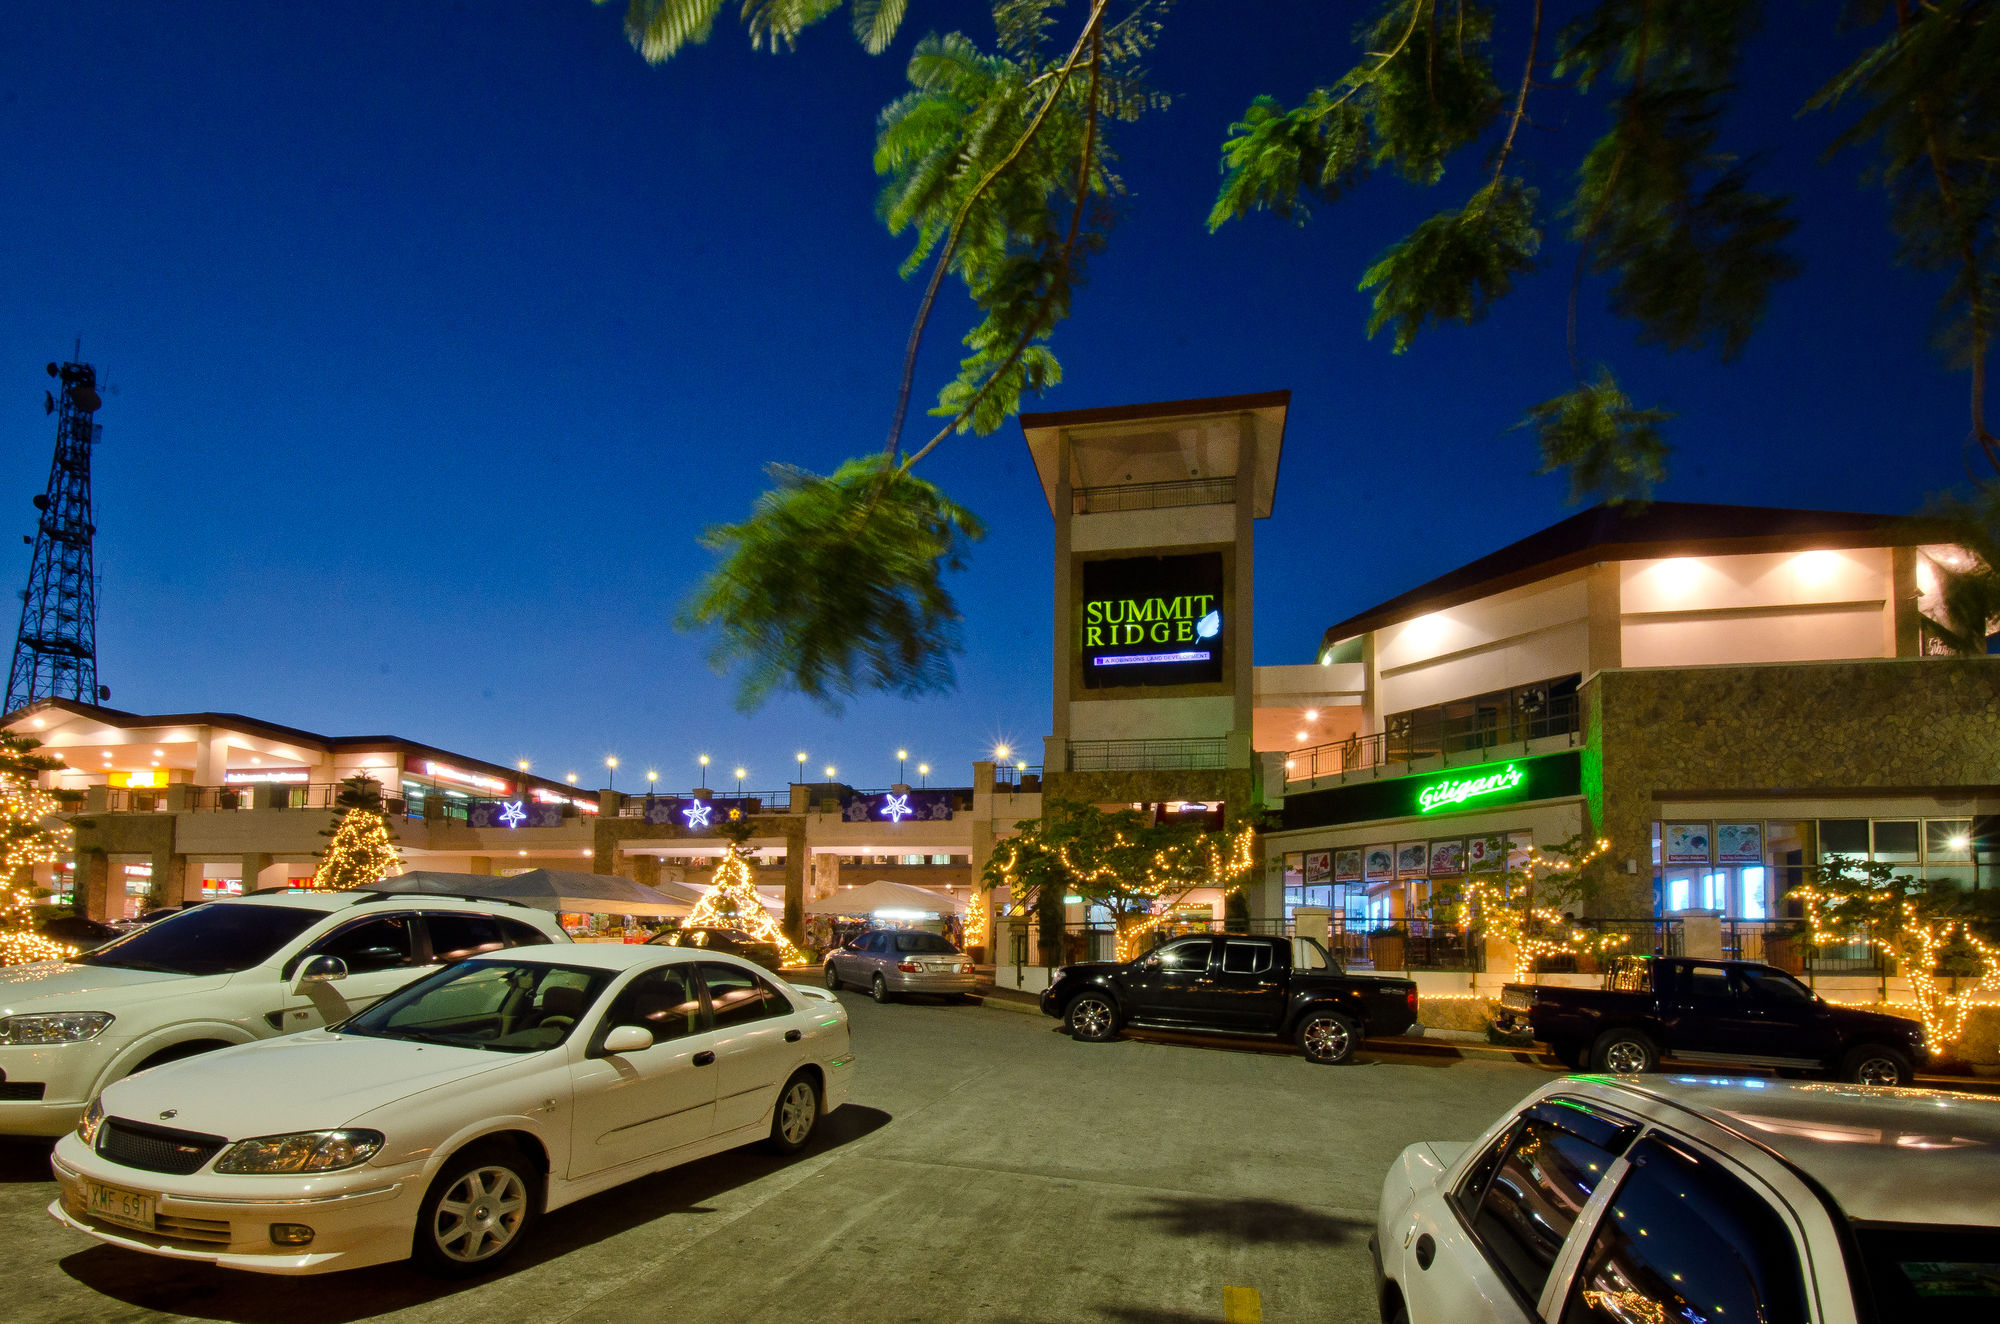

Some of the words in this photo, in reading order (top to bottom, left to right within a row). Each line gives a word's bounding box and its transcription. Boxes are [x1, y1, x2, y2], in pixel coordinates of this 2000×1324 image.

[1087, 595, 1214, 625] SUMMIT
[1086, 621, 1194, 647] RIDGE
[1419, 764, 1523, 807] Giligan's
[1320, 854, 1329, 869] 4
[1473, 841, 1484, 859] 3
